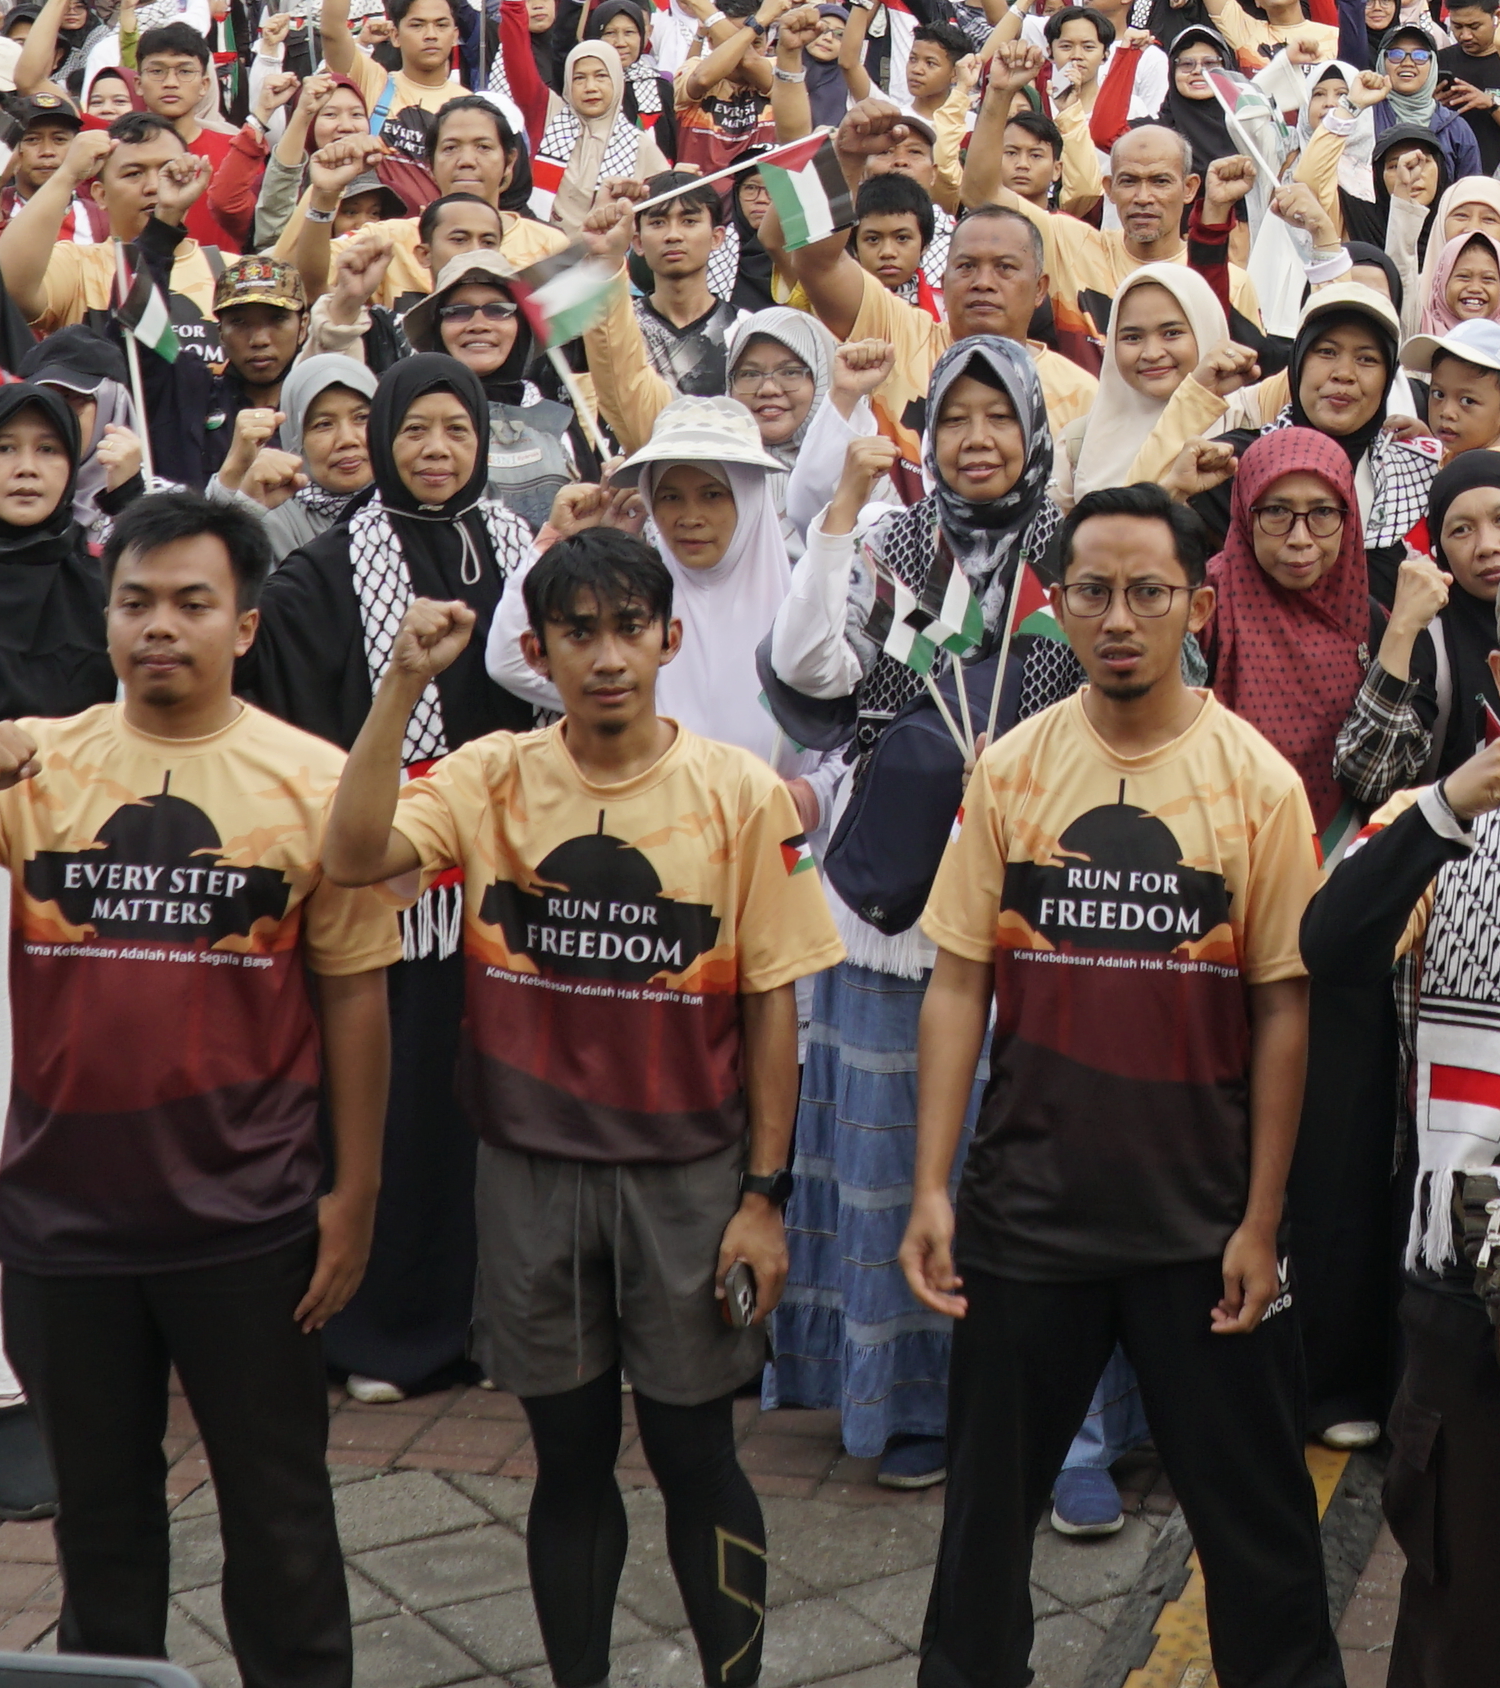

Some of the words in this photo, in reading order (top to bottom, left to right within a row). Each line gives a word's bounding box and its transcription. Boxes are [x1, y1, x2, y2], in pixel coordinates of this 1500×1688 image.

[63, 863, 163, 893] EVERY
[169, 866, 247, 898] STEP
[1067, 868, 1122, 891] RUN
[1128, 871, 1179, 895] FOR
[91, 897, 212, 926] MATTERS
[547, 898, 601, 921] RUN
[608, 902, 658, 926] FOR
[1039, 898, 1202, 935] FREEDOM
[120, 947, 164, 961] Adalah
[169, 950, 195, 963] Hak
[199, 952, 238, 967] Segala
[526, 923, 683, 966] FREEDOM
[1035, 952, 1094, 967] Kebebasan
[1096, 956, 1137, 969] Adalah
[1140, 959, 1164, 971] Hak
[1199, 962, 1240, 978] Bangsa
[519, 973, 573, 994] Kebebasan
[574, 984, 615, 998] Adalah
[617, 988, 640, 1001] Hak
[642, 990, 680, 1004] Segala
